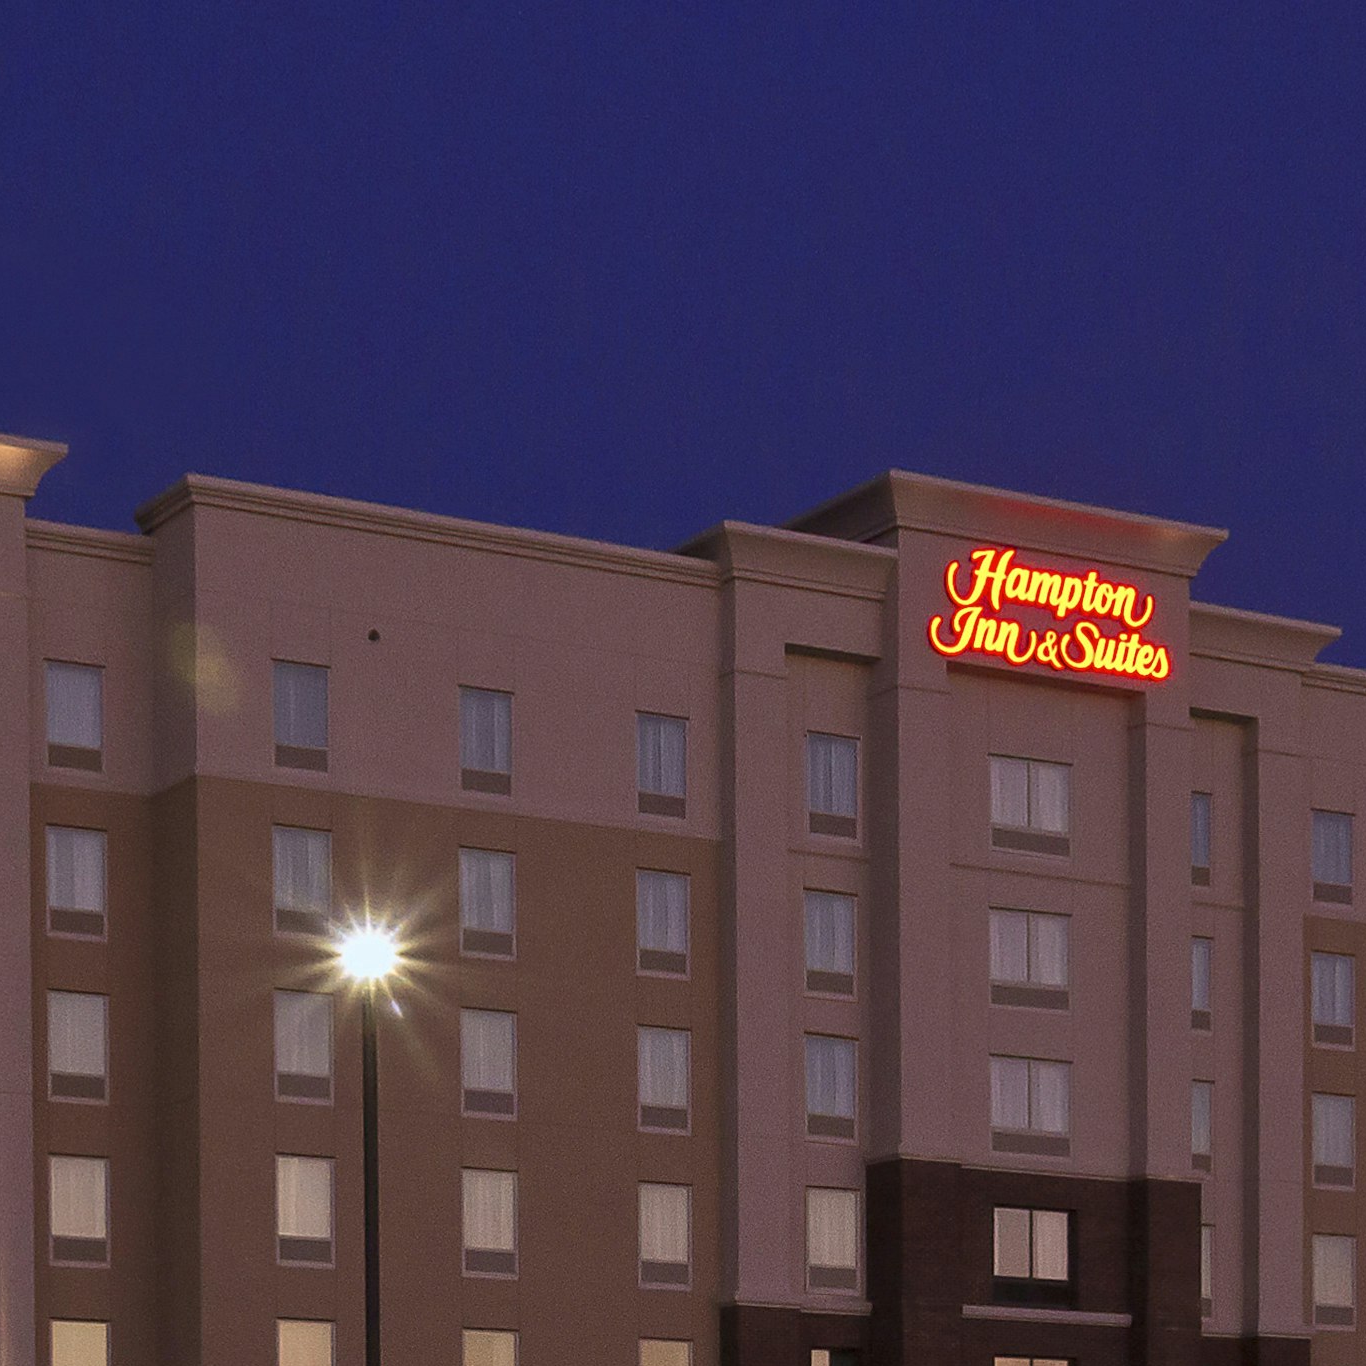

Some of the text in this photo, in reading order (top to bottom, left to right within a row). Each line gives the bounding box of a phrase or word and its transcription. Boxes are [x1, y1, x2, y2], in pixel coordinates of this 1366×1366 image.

[945, 548, 1155, 630] Hampton
[928, 605, 1172, 681] Inn & Suites
